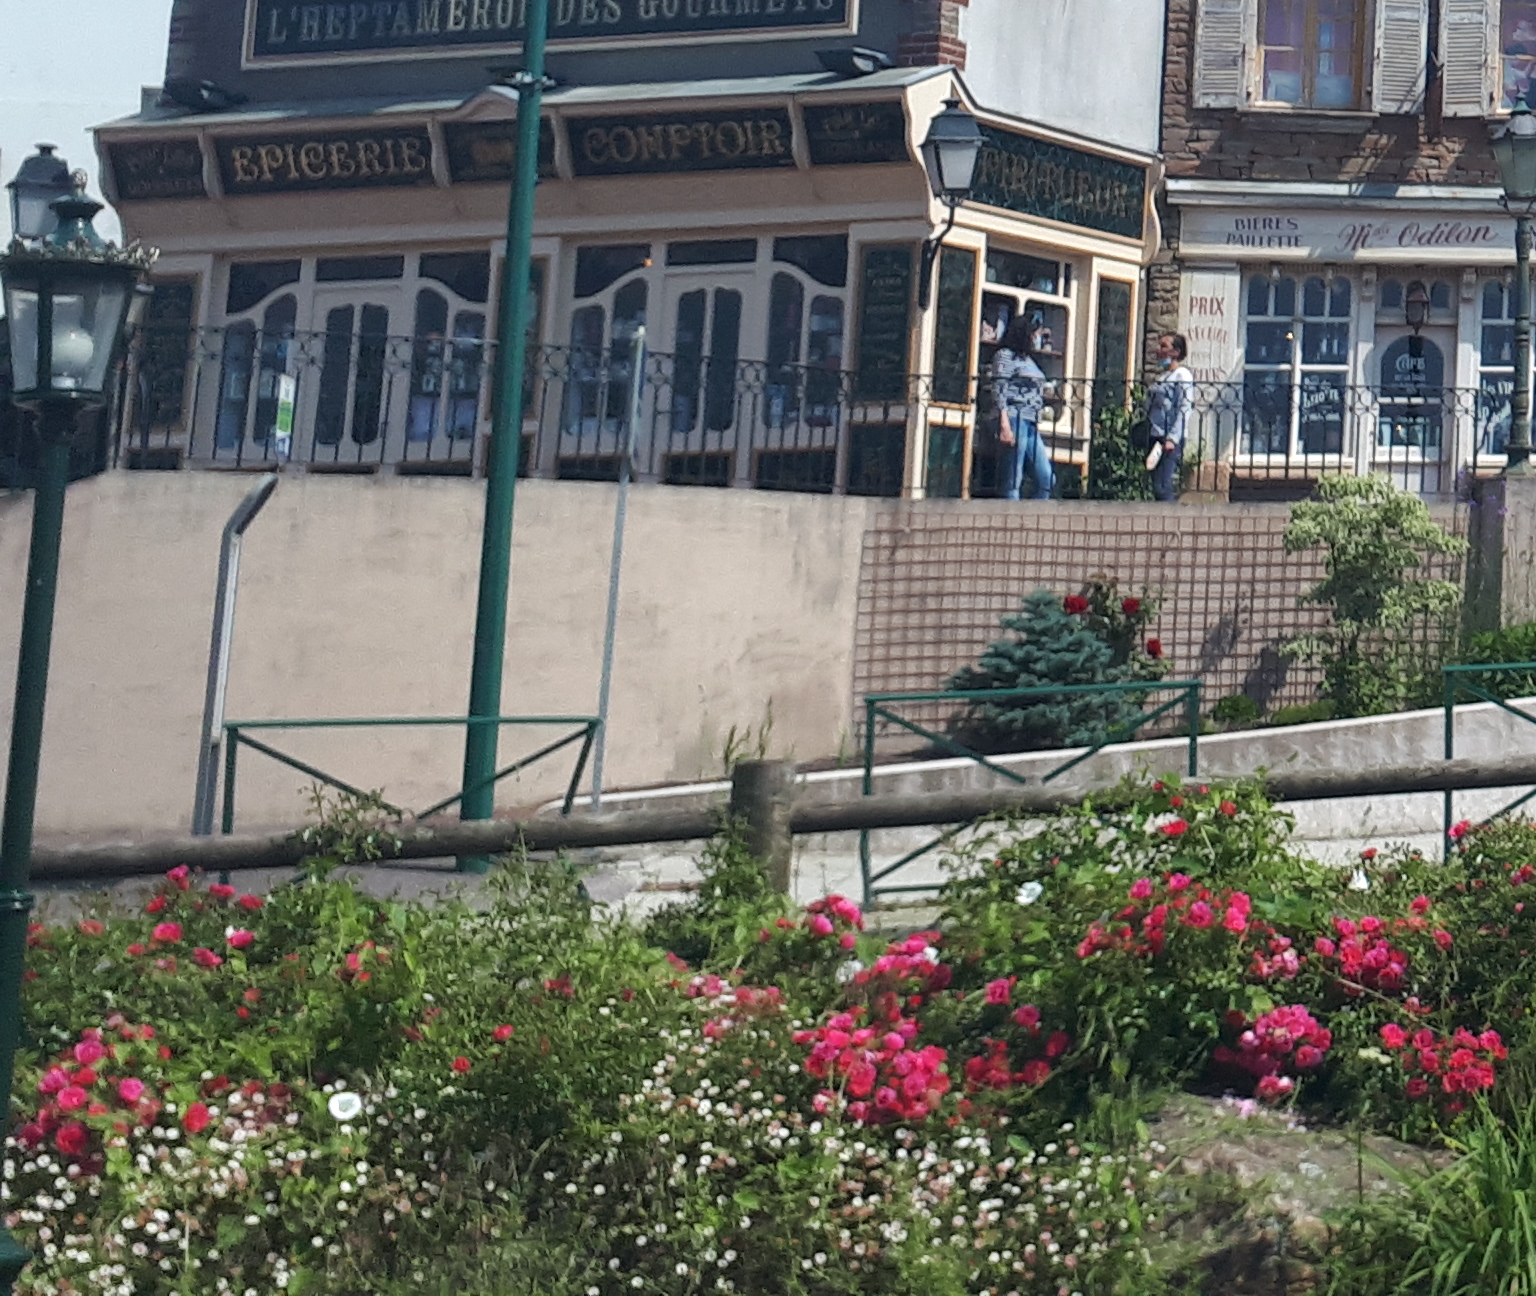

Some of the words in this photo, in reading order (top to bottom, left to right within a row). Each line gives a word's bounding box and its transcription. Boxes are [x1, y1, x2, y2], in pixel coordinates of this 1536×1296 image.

[584, 118, 786, 164] COMPTOIR
[231, 137, 427, 183] EPICERIE
[1398, 221, 1498, 247] Odilon
[1189, 297, 1225, 316] PRIX
